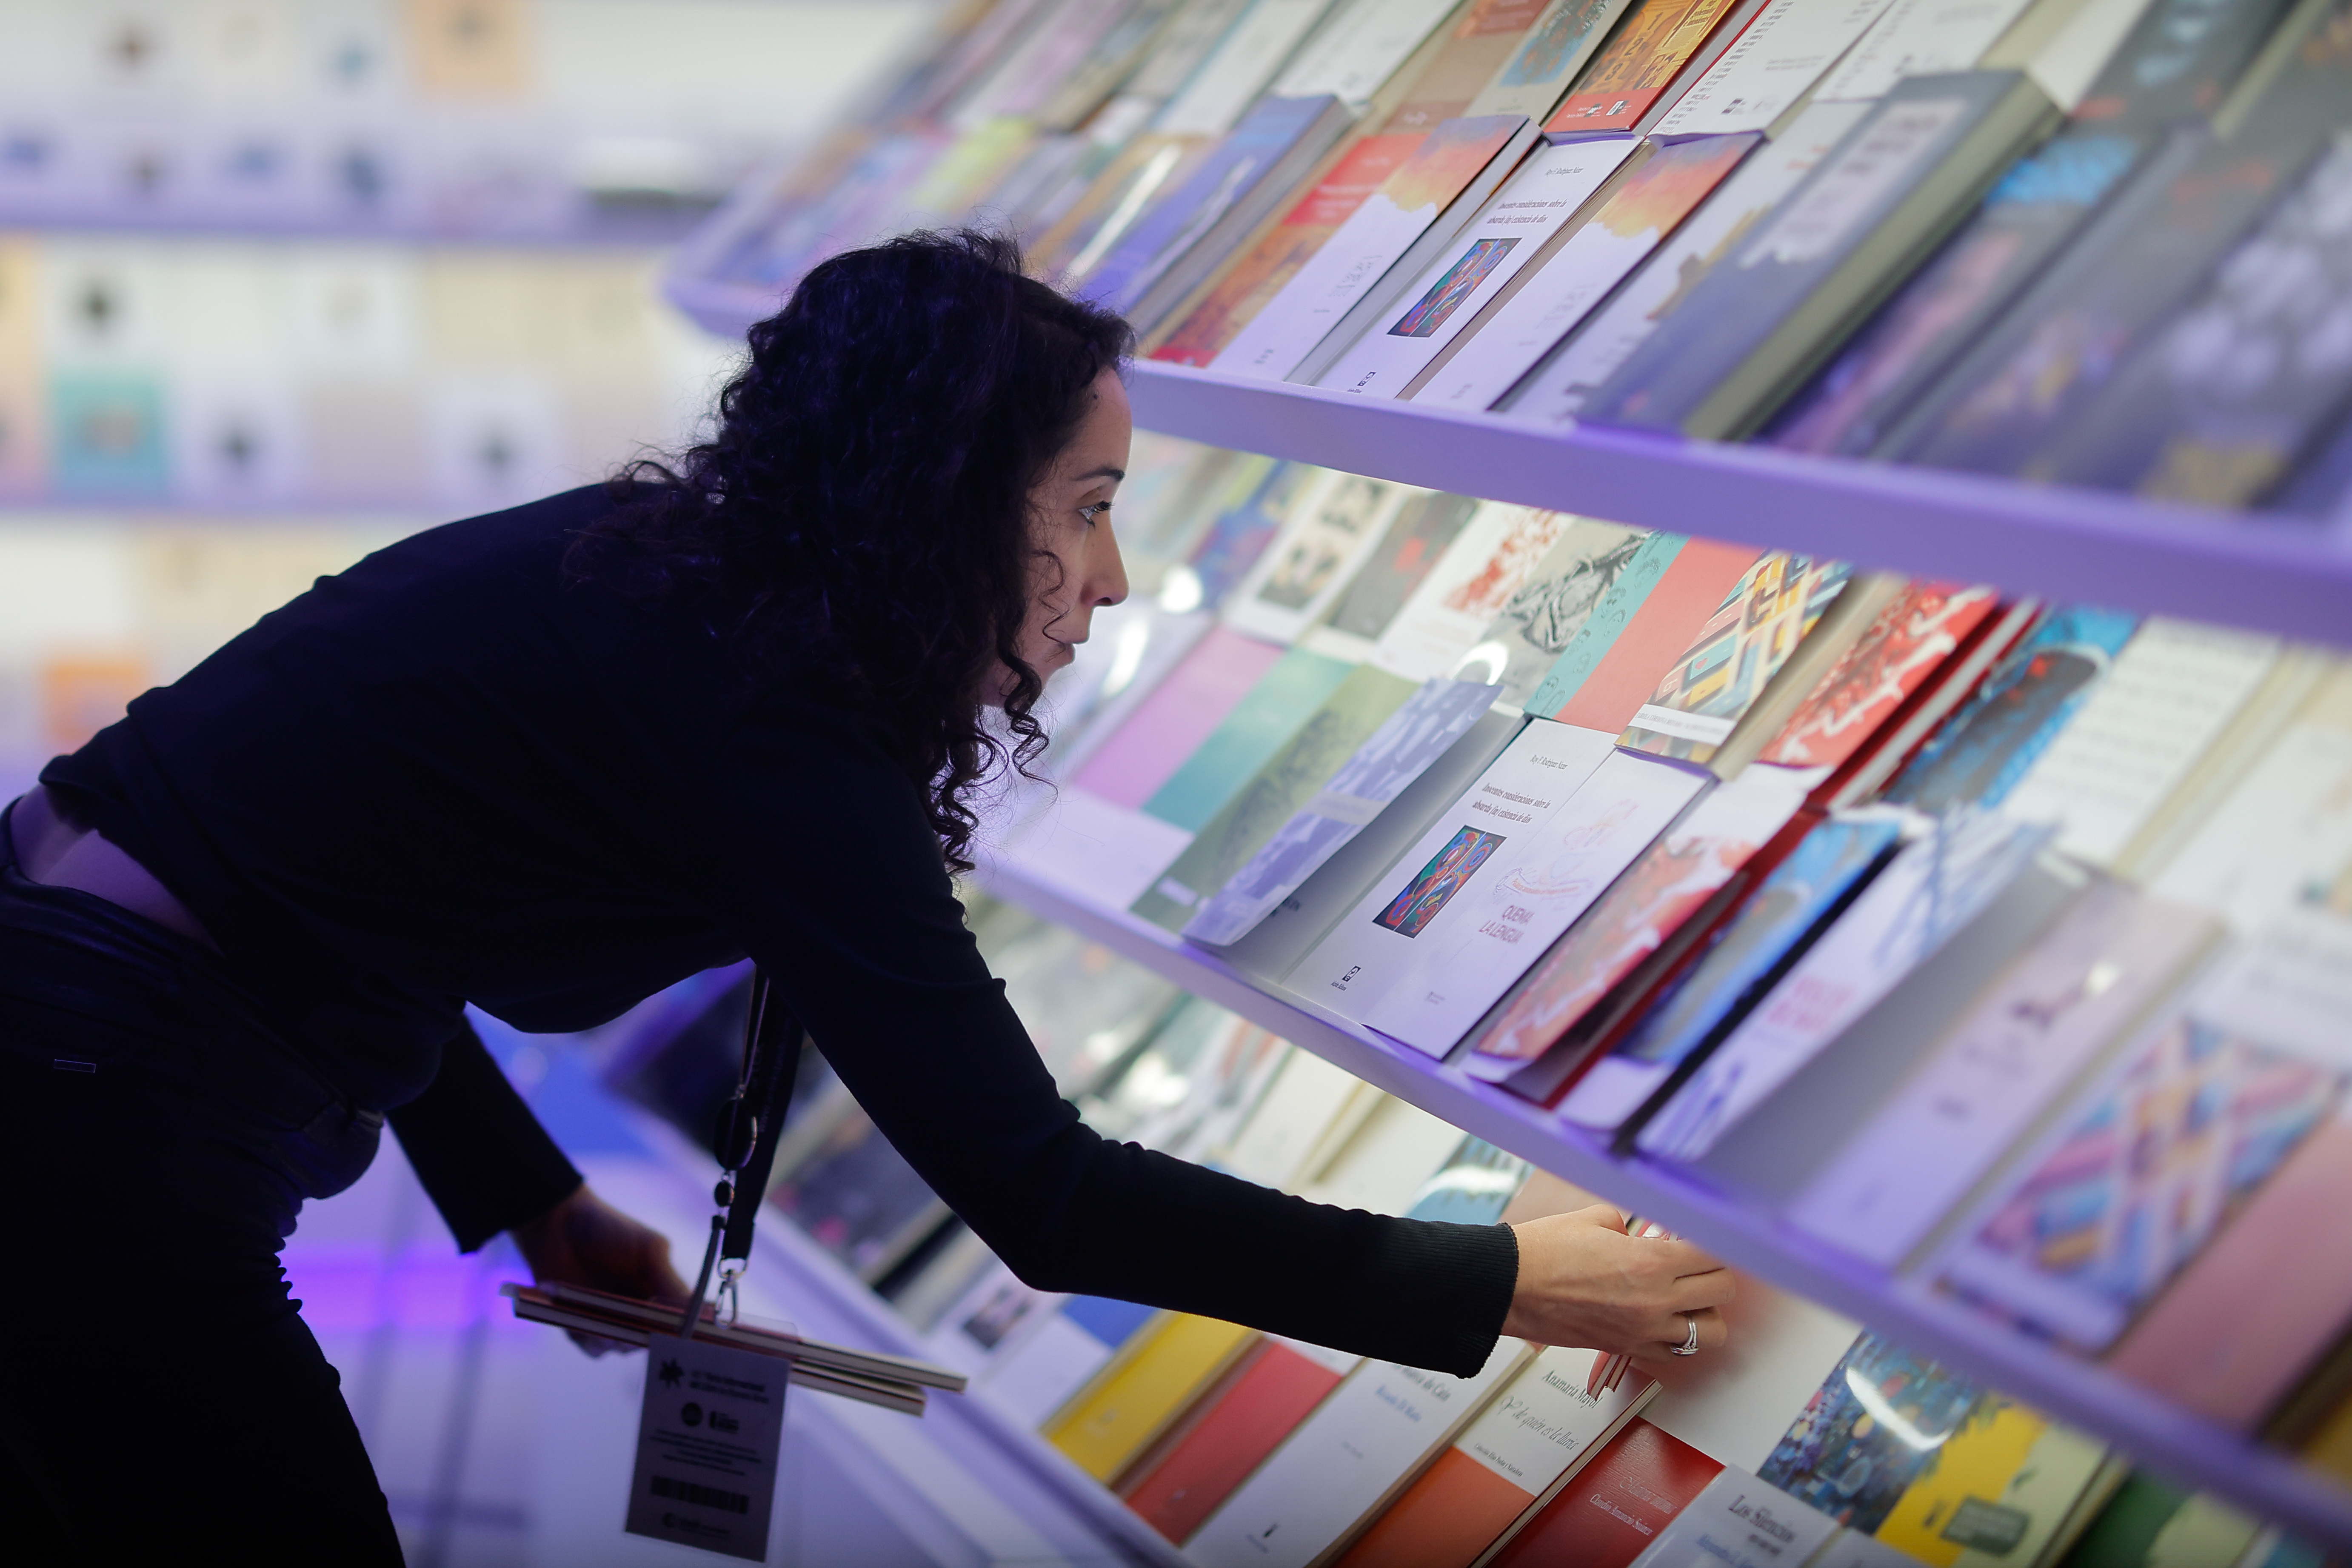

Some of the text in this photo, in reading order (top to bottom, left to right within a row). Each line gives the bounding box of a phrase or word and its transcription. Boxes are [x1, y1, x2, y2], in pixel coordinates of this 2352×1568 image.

[1515, 200, 1549, 209] consideraciones
[1547, 199, 1560, 208] sobre
[1558, 199, 1568, 208] la
[1510, 214, 1533, 224] existencia
[1530, 214, 1539, 224] de
[1536, 213, 1549, 224] dios
[1481, 782, 1552, 809] Inocentes consideraciones sobre la
[1472, 800, 1533, 824] absurda (in) existencia de dios
[1502, 905, 1535, 925] QUEMA
[1479, 920, 1525, 944] LA LENGUA
[1541, 1370, 1604, 1410] Anamaría Mayol
[1548, 1427, 1563, 1441] la
[1556, 1431, 1579, 1451] lluvia
[1590, 1493, 1612, 1511] Claudio
[1609, 1505, 1635, 1525] Amancio
[1728, 1494, 1755, 1520] Los
